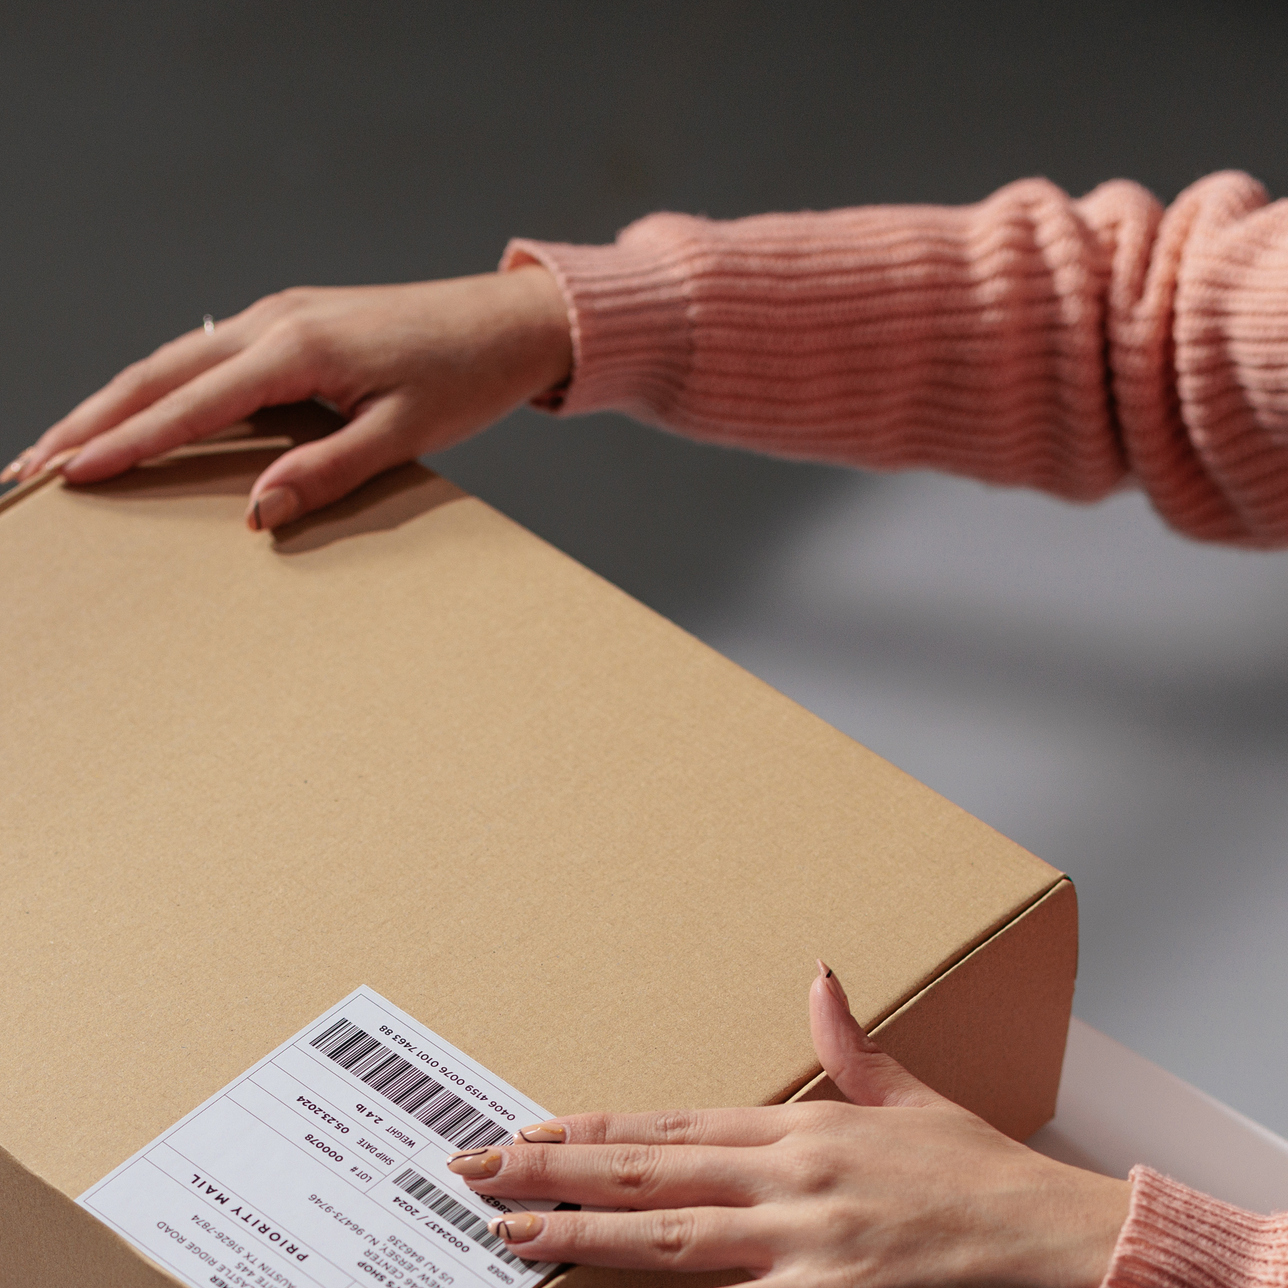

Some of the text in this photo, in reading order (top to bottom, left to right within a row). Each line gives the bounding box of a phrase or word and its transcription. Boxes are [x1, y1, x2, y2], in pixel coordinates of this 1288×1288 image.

[377, 1024, 517, 1122] 0406 4159 0076 0101 7463 88
[295, 1094, 396, 1167] SHIP DATE 05.23.2024
[364, 1110, 385, 1125] 2.4
[303, 1132, 345, 1163] 000078
[384, 1124, 417, 1150] WEIGHT
[354, 1169, 374, 1184] LOT
[190, 1172, 310, 1263] PRIORITY MAIL
[307, 1192, 366, 1236] 96473-9746
[391, 1195, 421, 1217] 2024
[155, 1220, 188, 1245] ROAD
[190, 1213, 246, 1255] 51626-7874
[363, 1233, 381, 1247] NJ
[423, 1220, 471, 1254] 0002437
[184, 1240, 219, 1268] RIDGE
[243, 1251, 259, 1265] TX
[362, 1248, 405, 1280] CENTER
[378, 1242, 420, 1274] JERSEY,
[386, 1234, 456, 1286] US NJ 846236
[234, 1261, 256, 1278] 445
[356, 1260, 388, 1283] SHOP
[486, 1263, 515, 1286] ORDER
